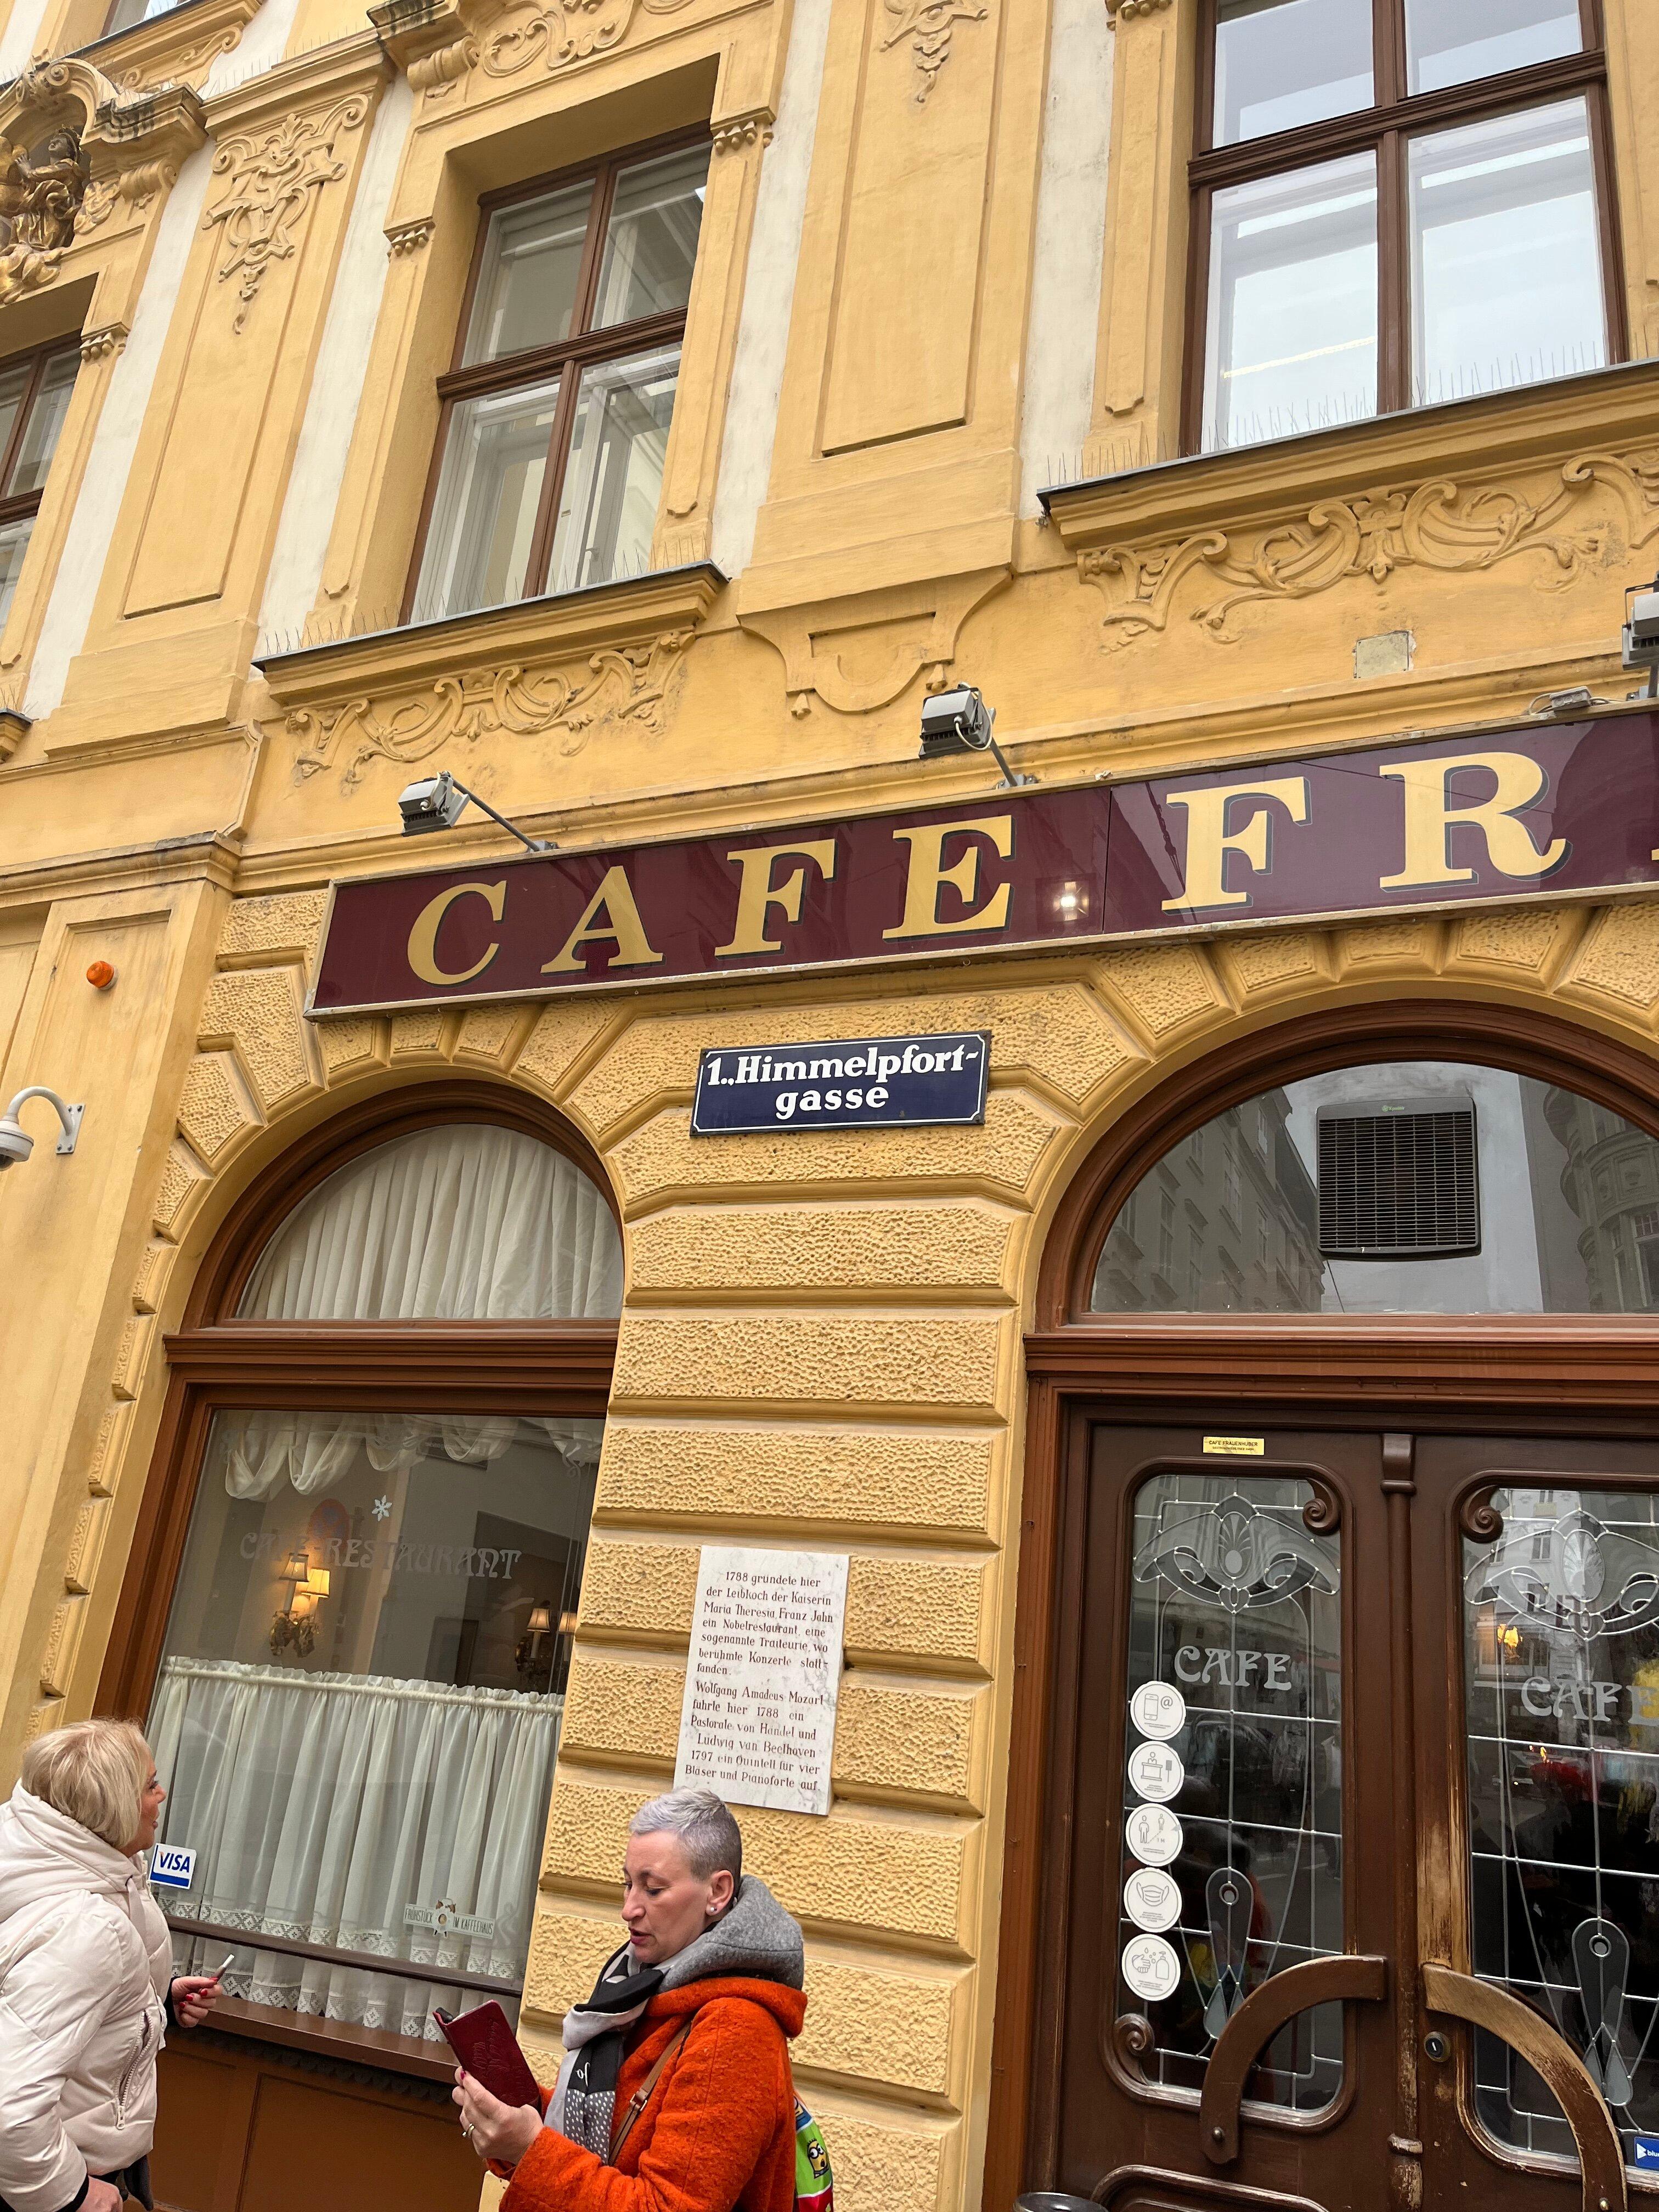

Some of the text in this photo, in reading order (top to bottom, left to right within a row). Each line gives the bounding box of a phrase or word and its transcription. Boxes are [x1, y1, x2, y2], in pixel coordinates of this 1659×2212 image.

[408, 751, 1659, 987] CAFE FR
[775, 1086, 889, 1120] gasse
[726, 1572, 748, 1582] 1788
[800, 1577, 821, 1587] hier
[706, 1586, 831, 1605] der Leibkoch der Kaiserin
[704, 1601, 731, 1614] Maria
[779, 1607, 807, 1621] Franz
[810, 1610, 833, 1623] Jahn
[702, 1618, 716, 1628] ein
[805, 1628, 826, 1637] eine
[701, 1634, 755, 1646] sogenannte
[813, 1644, 828, 1652] wo
[697, 1663, 731, 1675] fanden.
[749, 1651, 792, 1666] Konzerte
[1174, 1645, 1292, 1691] CAFE
[696, 1680, 823, 1705] Wolfgang Amadeus Mozart
[1521, 1676, 1659, 1726] CAFE
[727, 1702, 748, 1714] hier
[757, 1707, 778, 1718] 1788
[789, 1711, 804, 1721] ein
[691, 1714, 733, 1730] Pastorale
[737, 1724, 755, 1733] von
[798, 1729, 816, 1740] und
[697, 1733, 815, 1758] Ludwig van Beethoven
[691, 1750, 713, 1762] 1797
[718, 1754, 732, 1764] ein
[779, 1760, 794, 1771] für
[799, 1763, 820, 1774] vier
[720, 1770, 737, 1780] und
[741, 1771, 794, 1787] Pianoforte
[159, 1852, 190, 1873] VISA
[453, 1916, 460, 1928] IM
